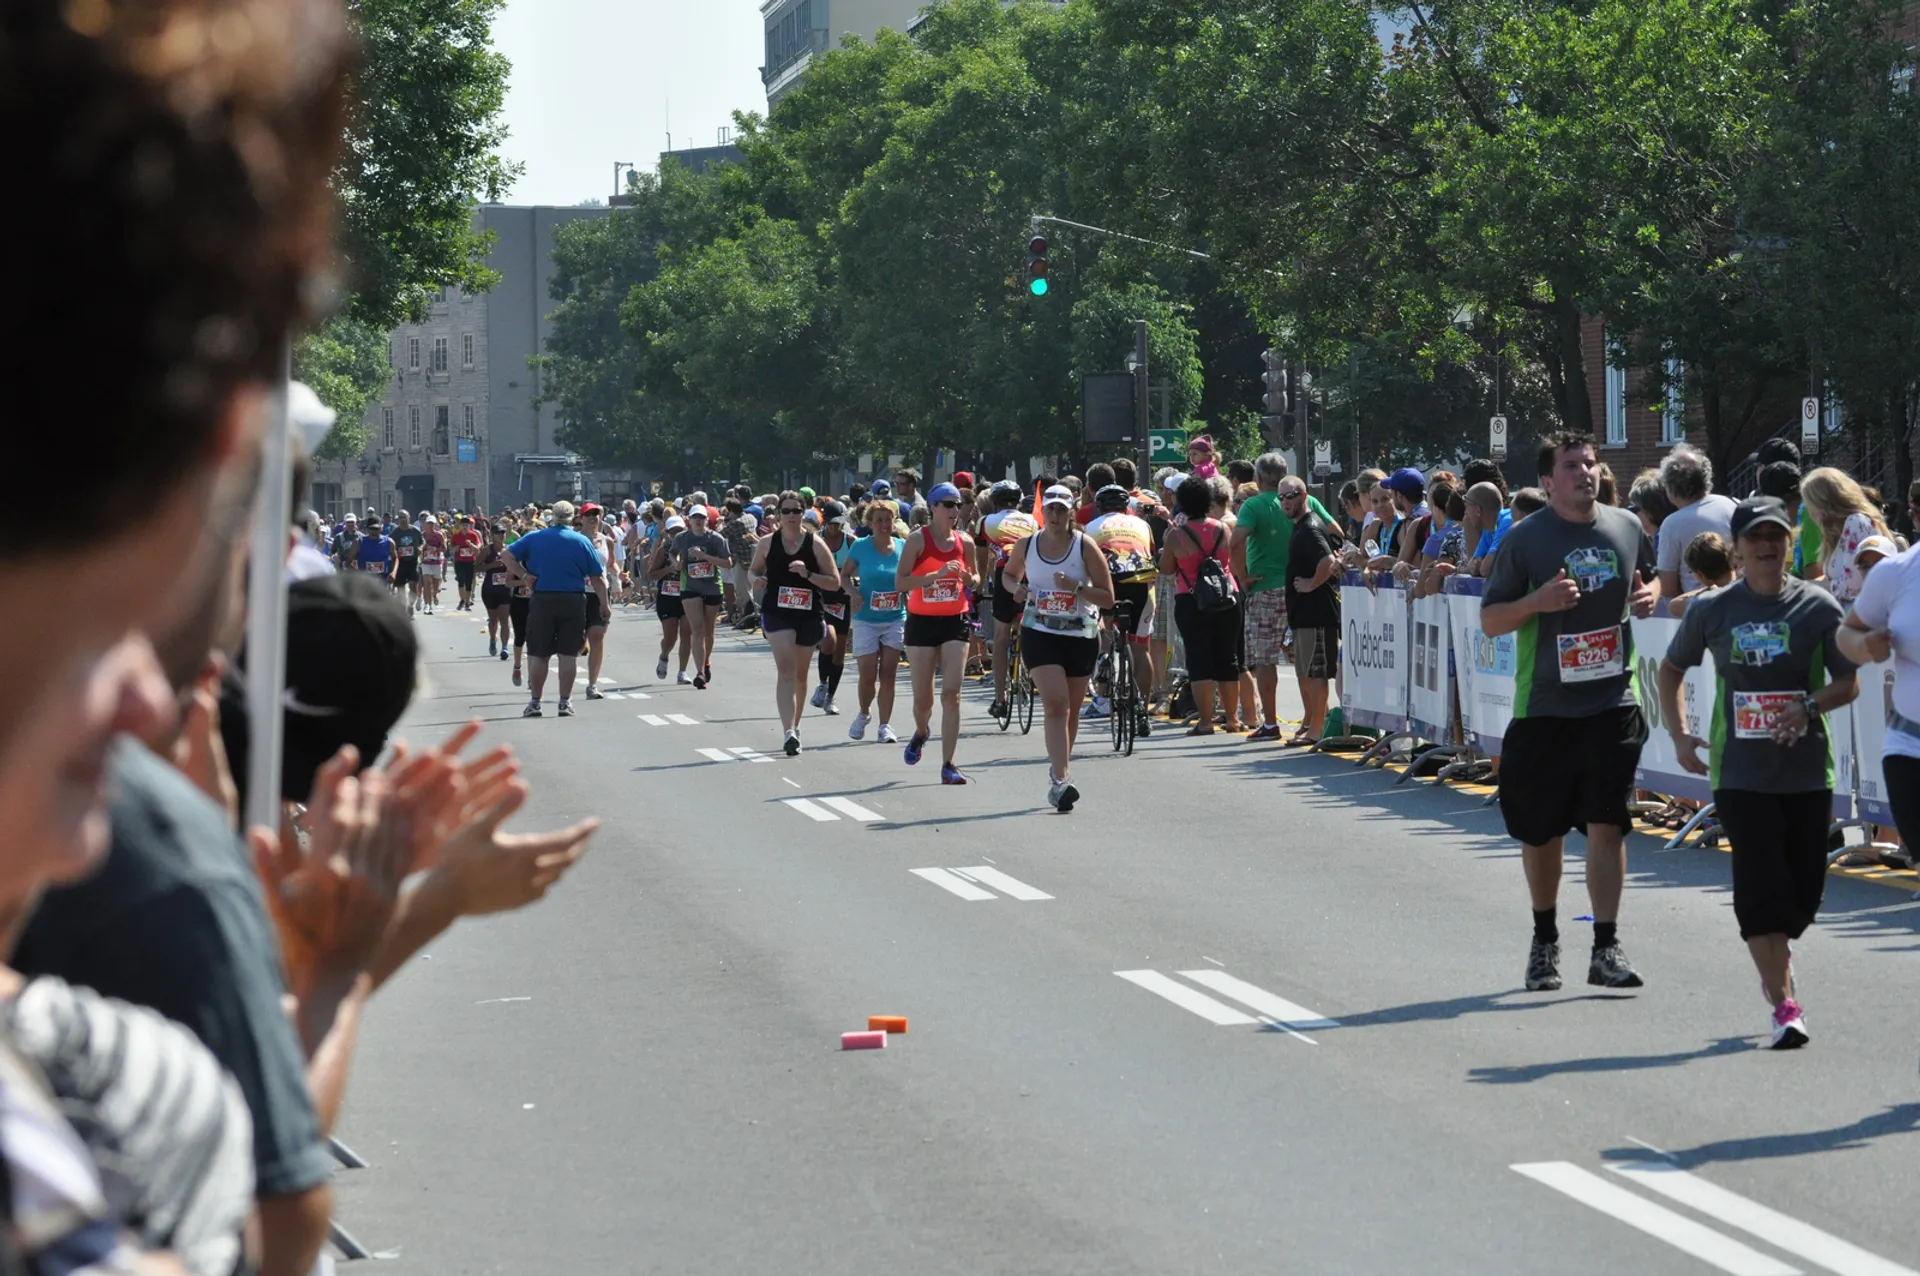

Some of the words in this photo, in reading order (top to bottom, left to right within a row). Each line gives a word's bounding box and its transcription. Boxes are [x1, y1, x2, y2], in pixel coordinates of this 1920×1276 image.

[1149, 435, 1166, 457] P
[786, 595, 804, 606] 7407
[932, 588, 952, 598] 4820
[1348, 618, 1382, 678] Québec
[1577, 647, 1610, 665] 6226
